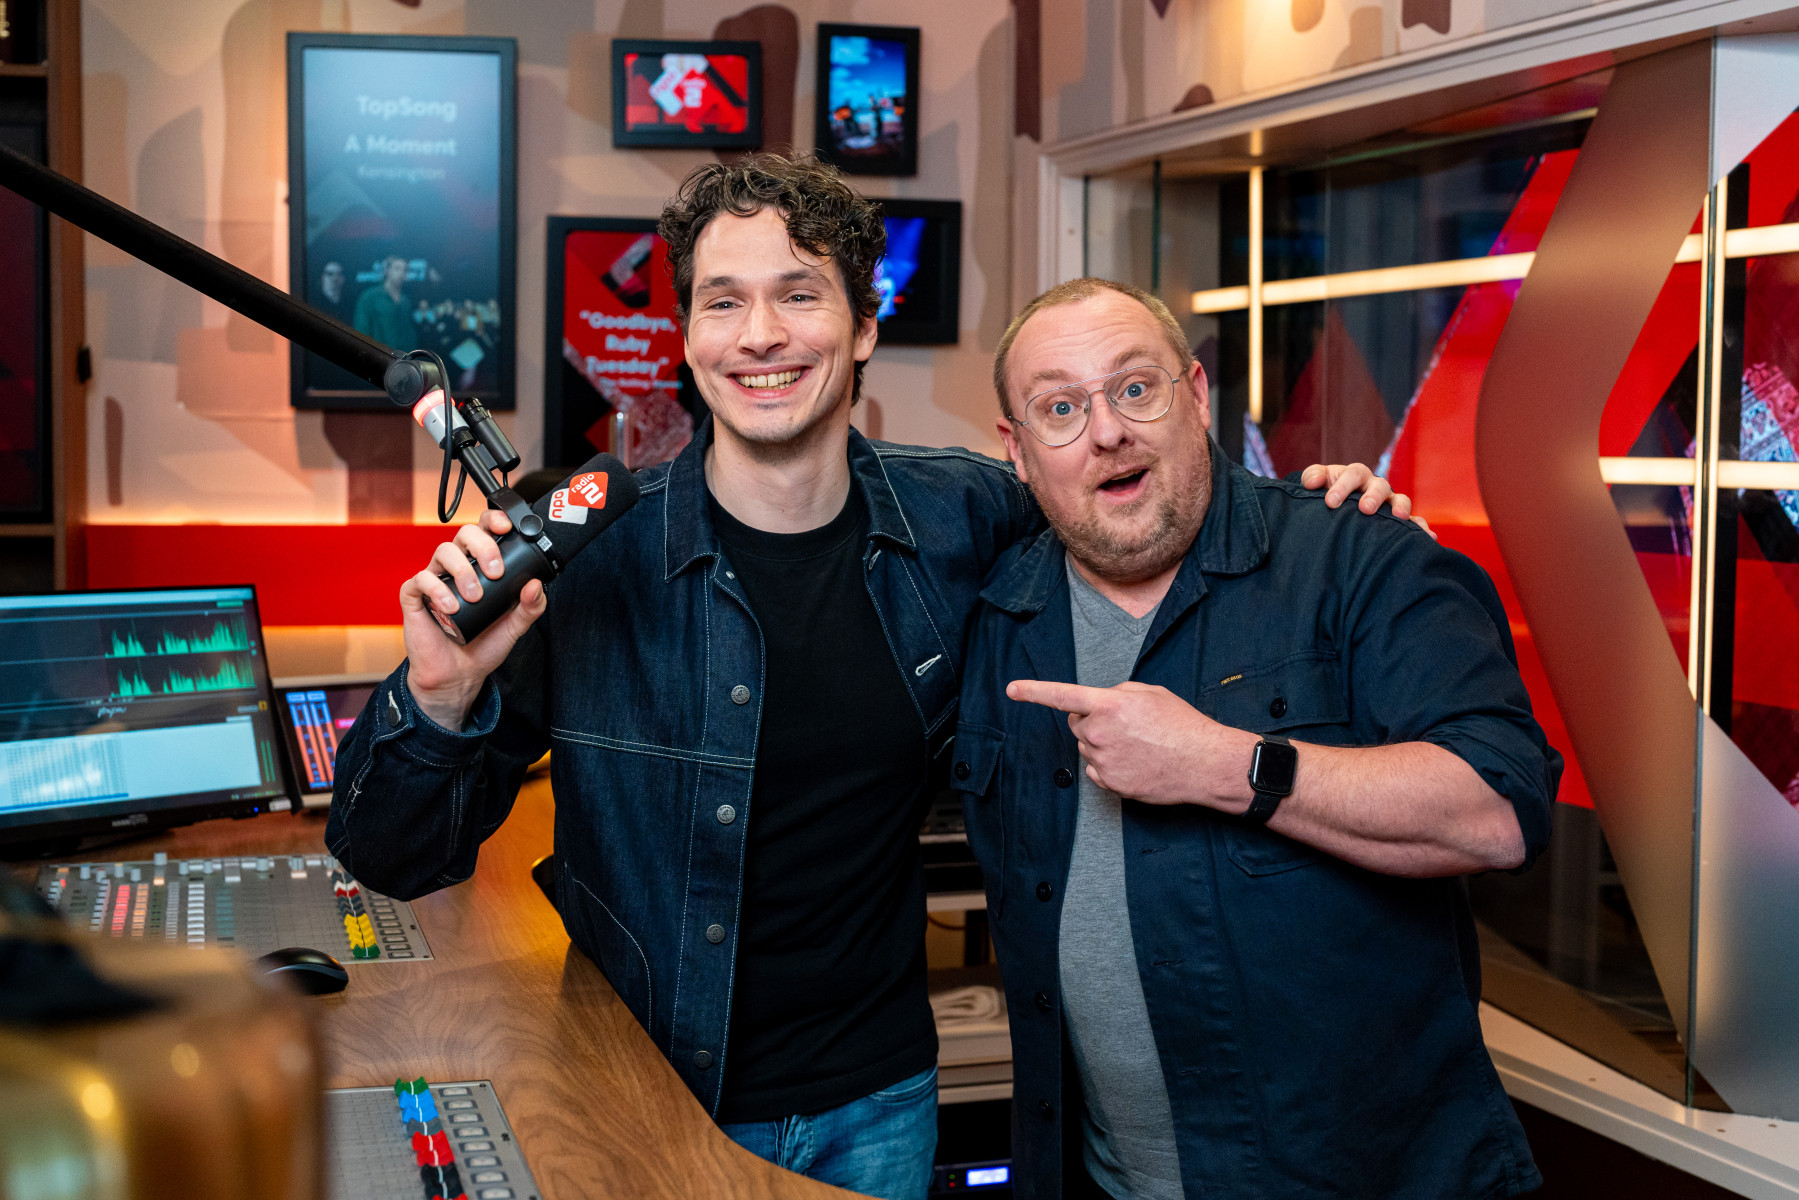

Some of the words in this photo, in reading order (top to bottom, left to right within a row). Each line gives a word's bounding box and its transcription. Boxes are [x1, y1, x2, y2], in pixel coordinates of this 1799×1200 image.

[355, 95, 457, 122] TopSong
[344, 134, 361, 153] A
[366, 134, 456, 155] Moment
[605, 334, 651, 356] Ruby
[571, 474, 595, 494] radio
[580, 482, 604, 505] 2
[552, 491, 565, 519] npo
